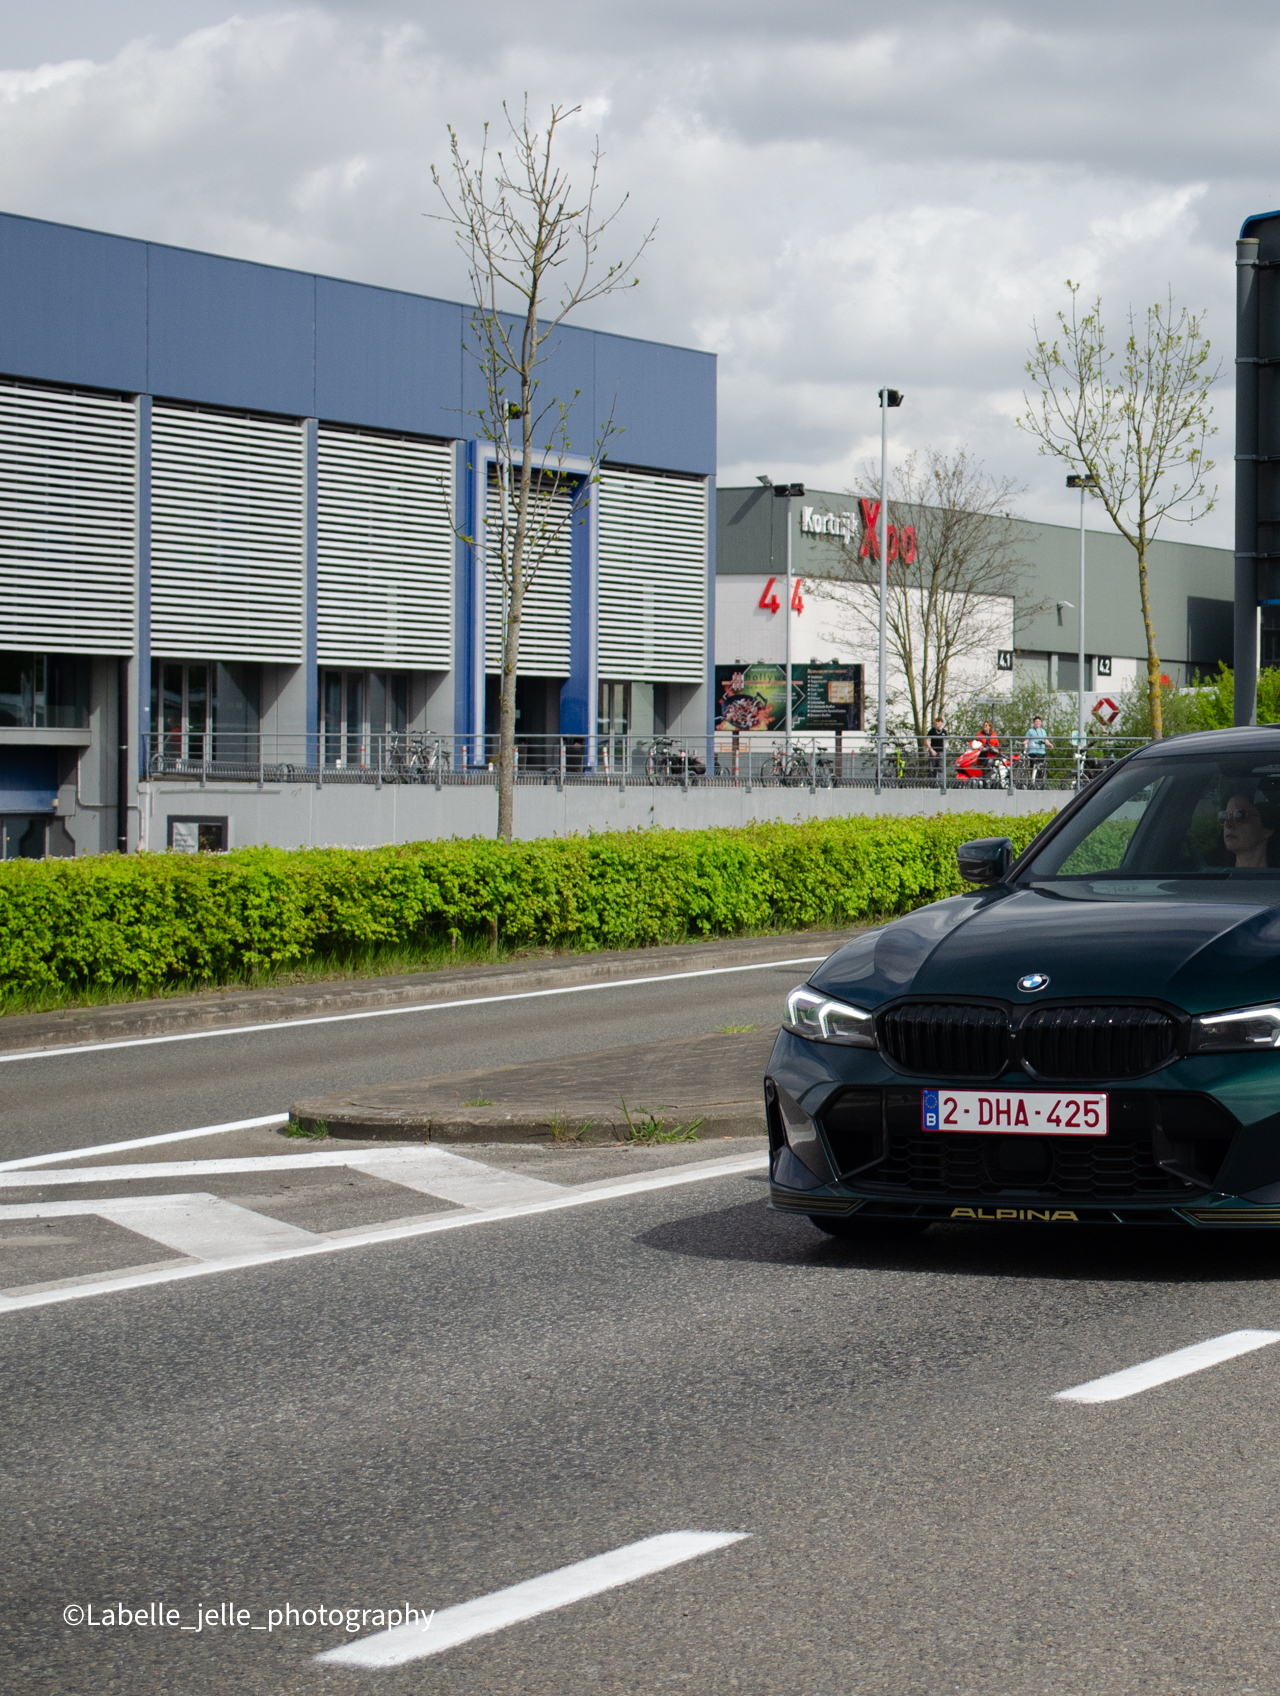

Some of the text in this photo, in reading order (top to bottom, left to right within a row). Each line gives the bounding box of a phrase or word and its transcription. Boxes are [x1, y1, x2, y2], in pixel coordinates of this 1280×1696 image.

[802, 498, 917, 575] Kortrijk Xpo
[758, 577, 781, 614] 4
[791, 578, 804, 615] 4
[999, 653, 1011, 667] 4.1
[1099, 659, 1110, 673] 4.2
[926, 1113, 936, 1126] B
[950, 1207, 1079, 1222] ALPINA
